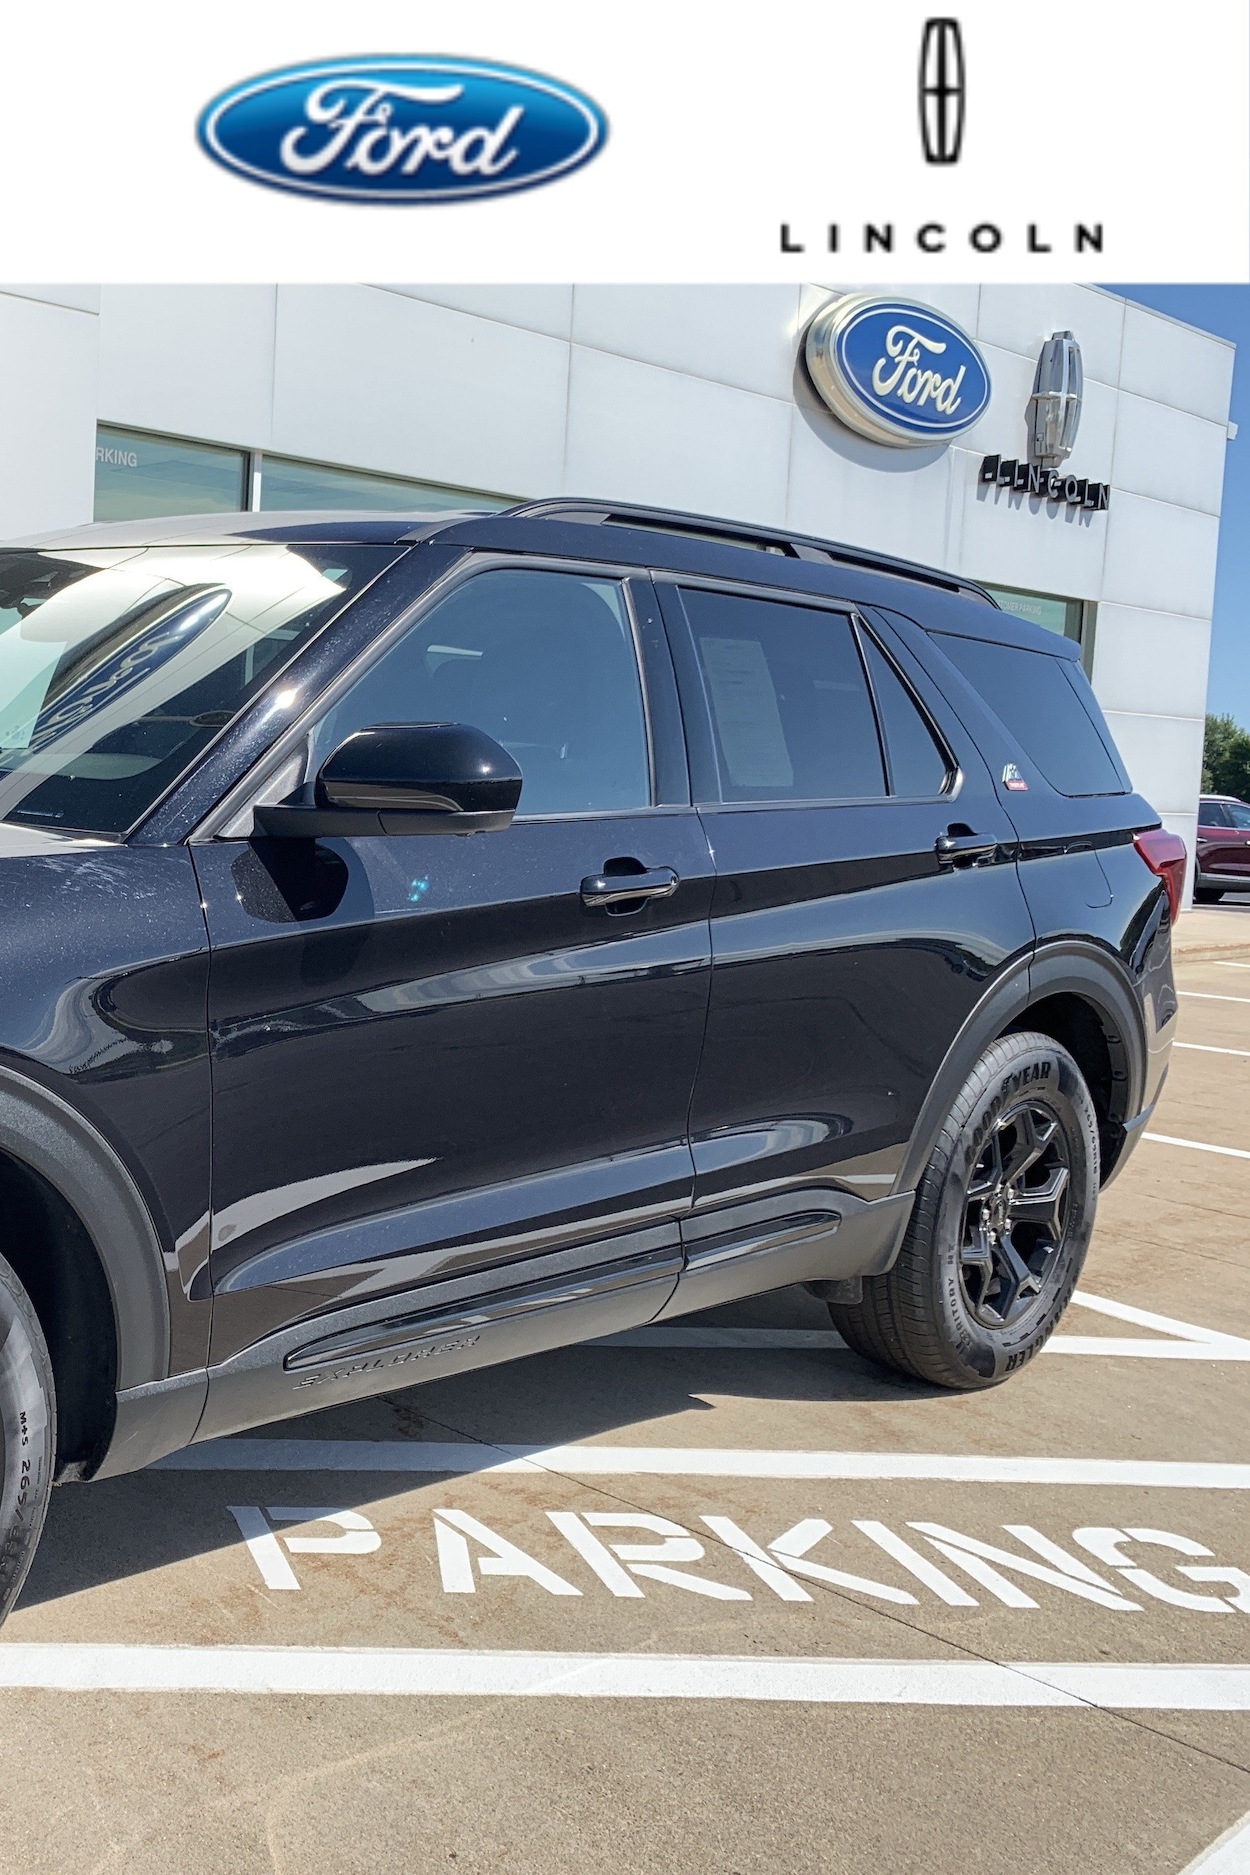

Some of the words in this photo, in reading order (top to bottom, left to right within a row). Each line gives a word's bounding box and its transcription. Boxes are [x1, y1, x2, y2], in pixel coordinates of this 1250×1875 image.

[871, 325, 967, 416] Ford
[986, 453, 1110, 511] LINCOLN
[19, 1411, 29, 1447] M+S
[226, 1506, 1250, 1614] PARKING
